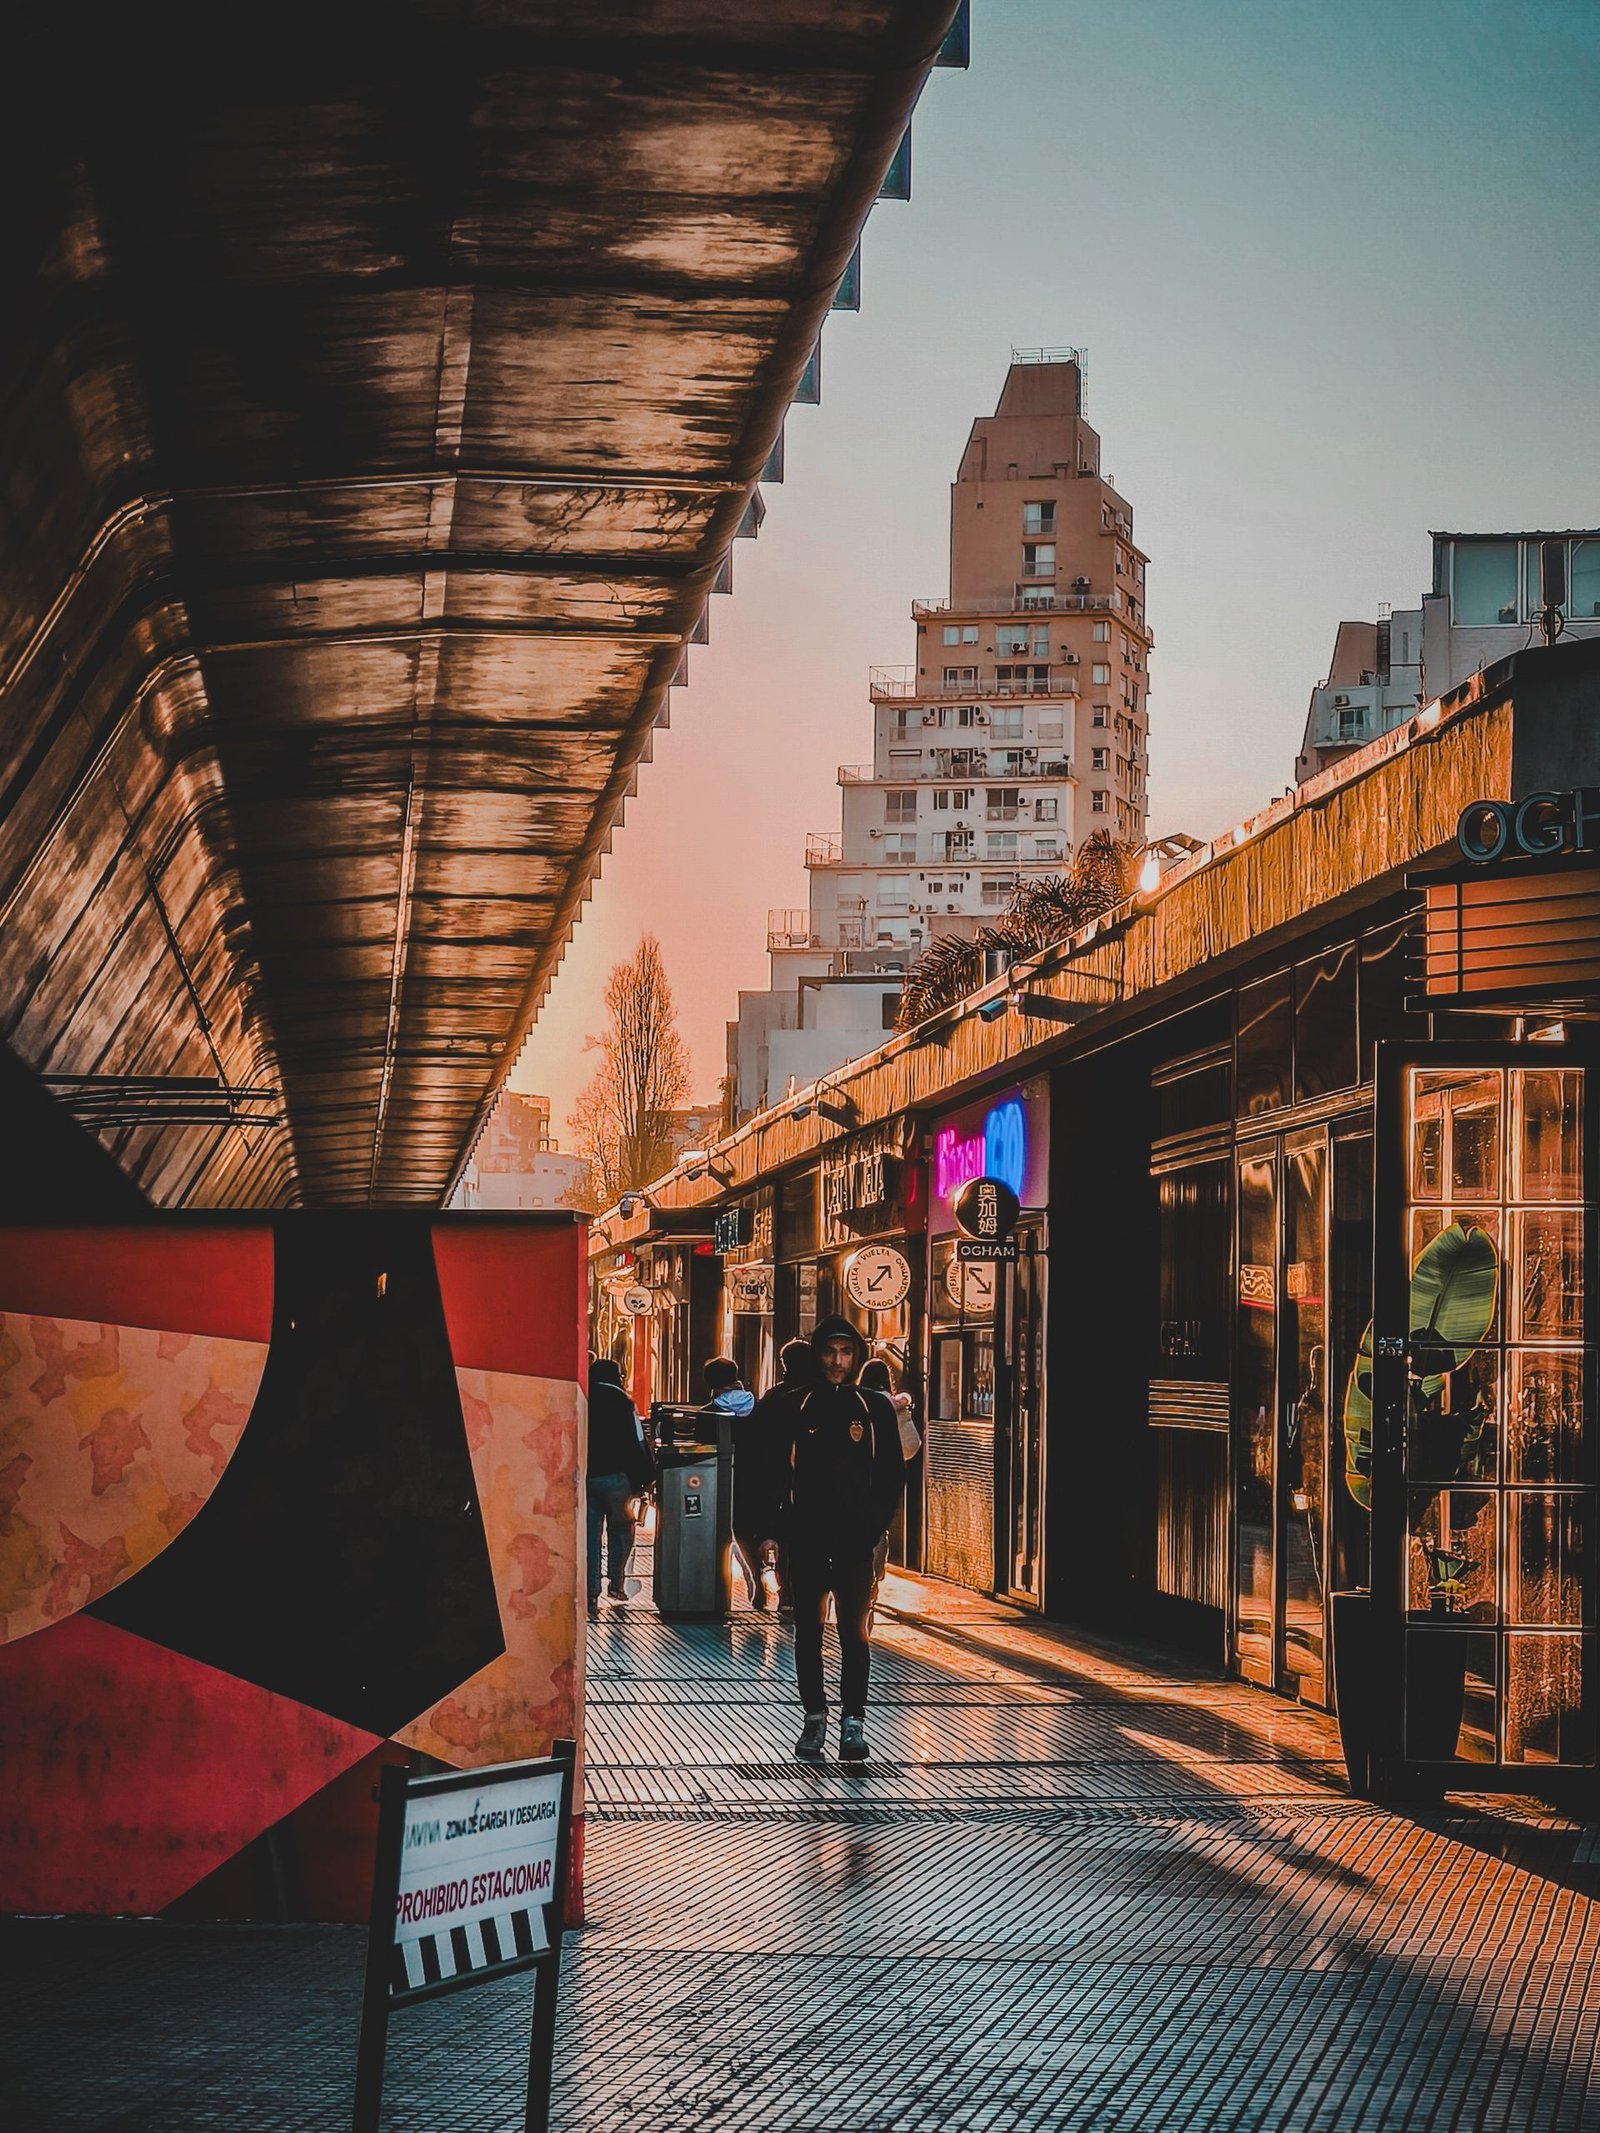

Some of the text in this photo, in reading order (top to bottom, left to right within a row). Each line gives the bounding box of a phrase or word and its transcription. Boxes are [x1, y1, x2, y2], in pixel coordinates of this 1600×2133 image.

[860, 1248, 890, 1261] VUELTA
[960, 1245, 1015, 1257] OGHAM
[445, 1818, 468, 1841] ZONA
[479, 1808, 508, 1832] CARGA
[509, 1808, 516, 1827] Y
[516, 1800, 557, 1826] DESCARGA
[395, 1859, 552, 1925] PROHIBIDO ESTACIONAR
